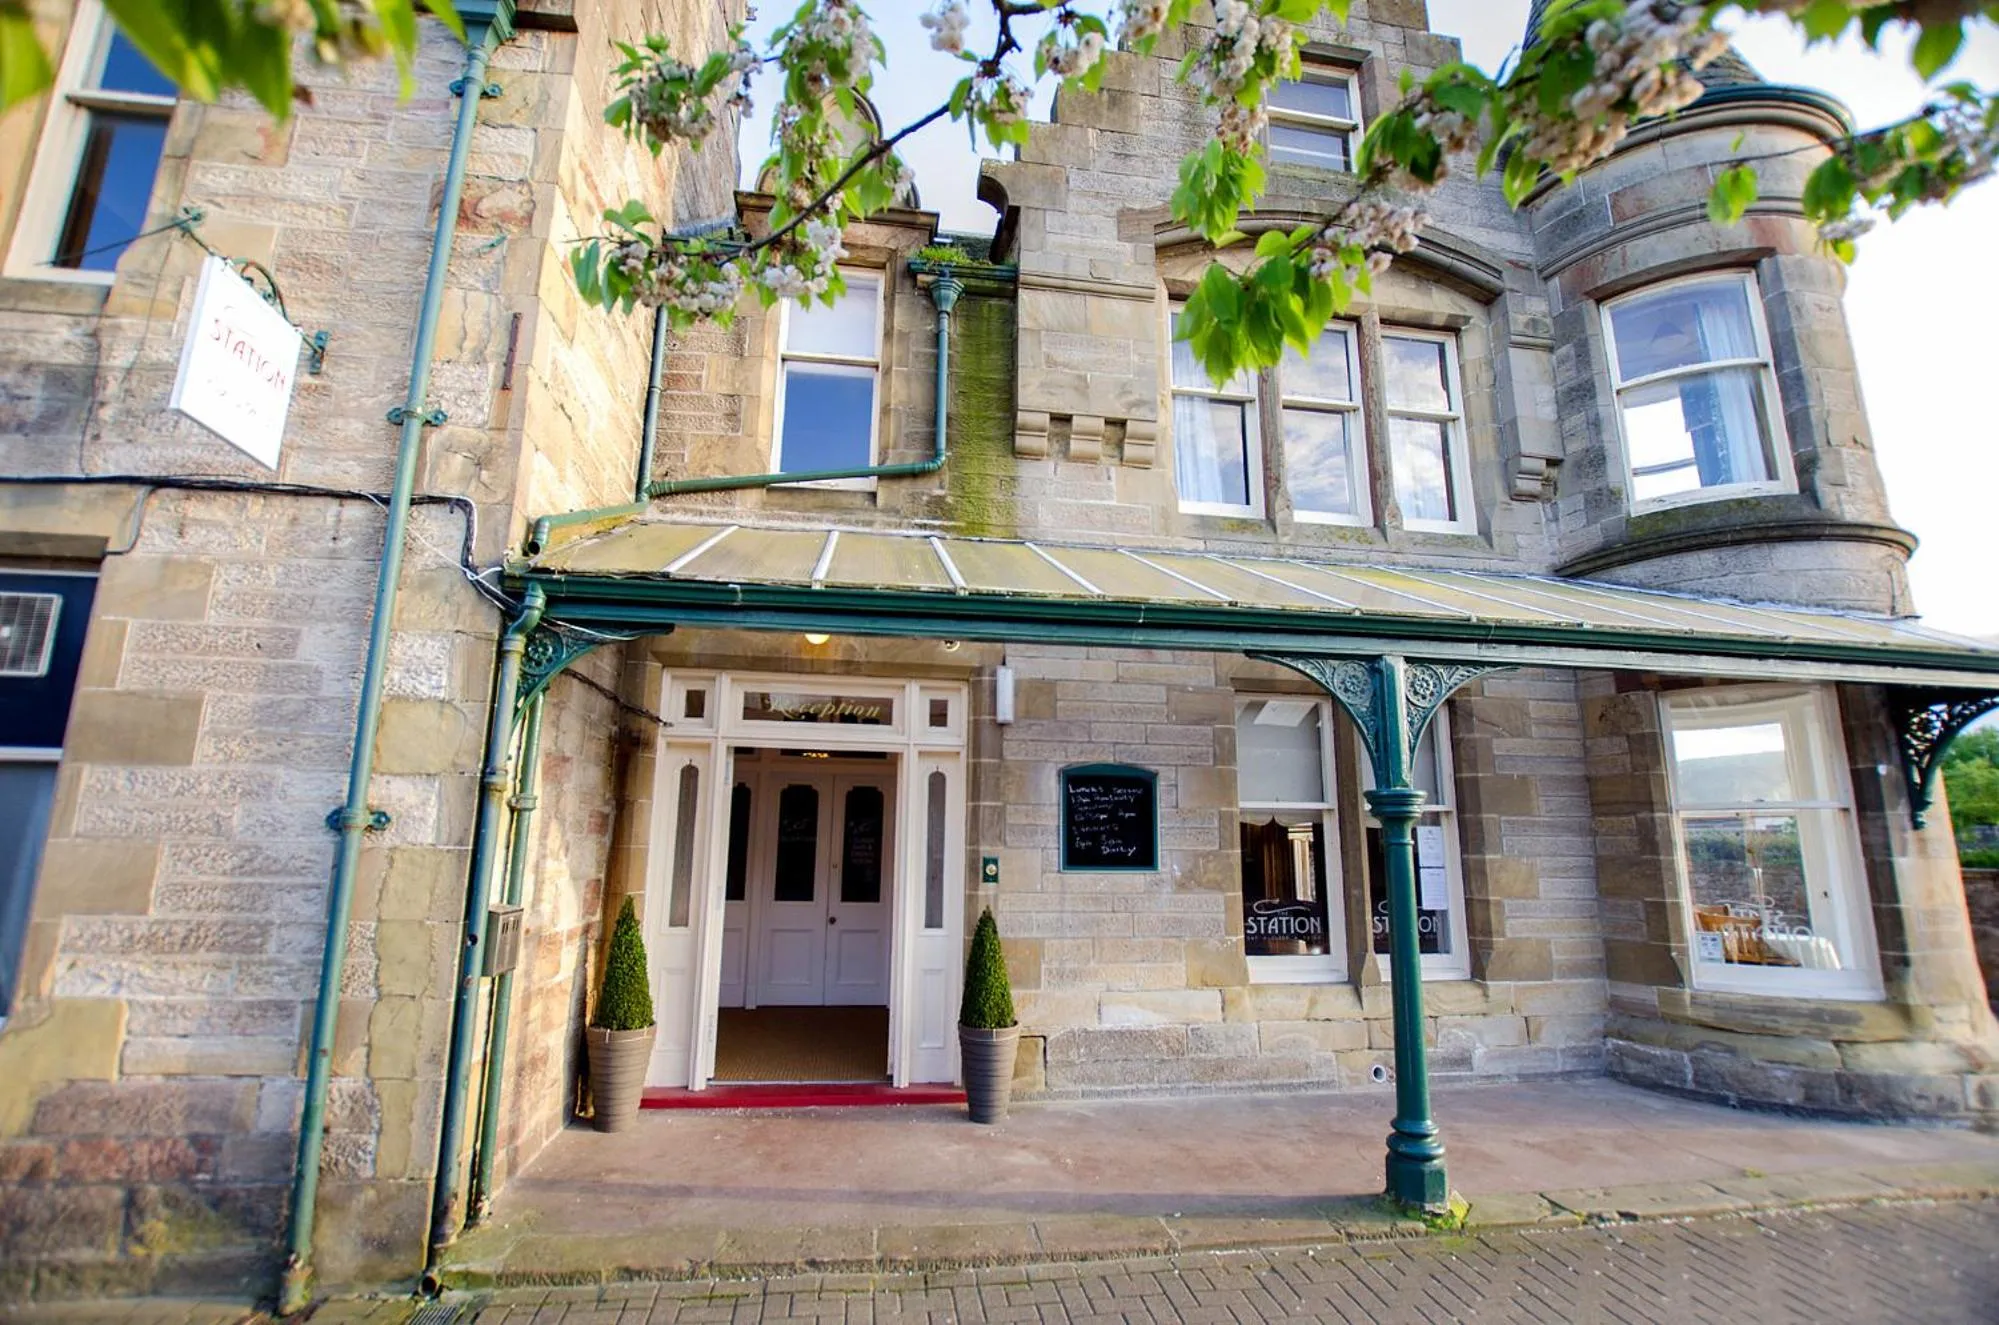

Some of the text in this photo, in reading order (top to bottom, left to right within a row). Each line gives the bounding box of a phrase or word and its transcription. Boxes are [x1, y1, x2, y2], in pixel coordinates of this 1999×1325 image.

[210, 319, 286, 391] STATION
[765, 696, 881, 719] Reception
[1246, 917, 1320, 934] STATION
[1373, 916, 1439, 934] STON
